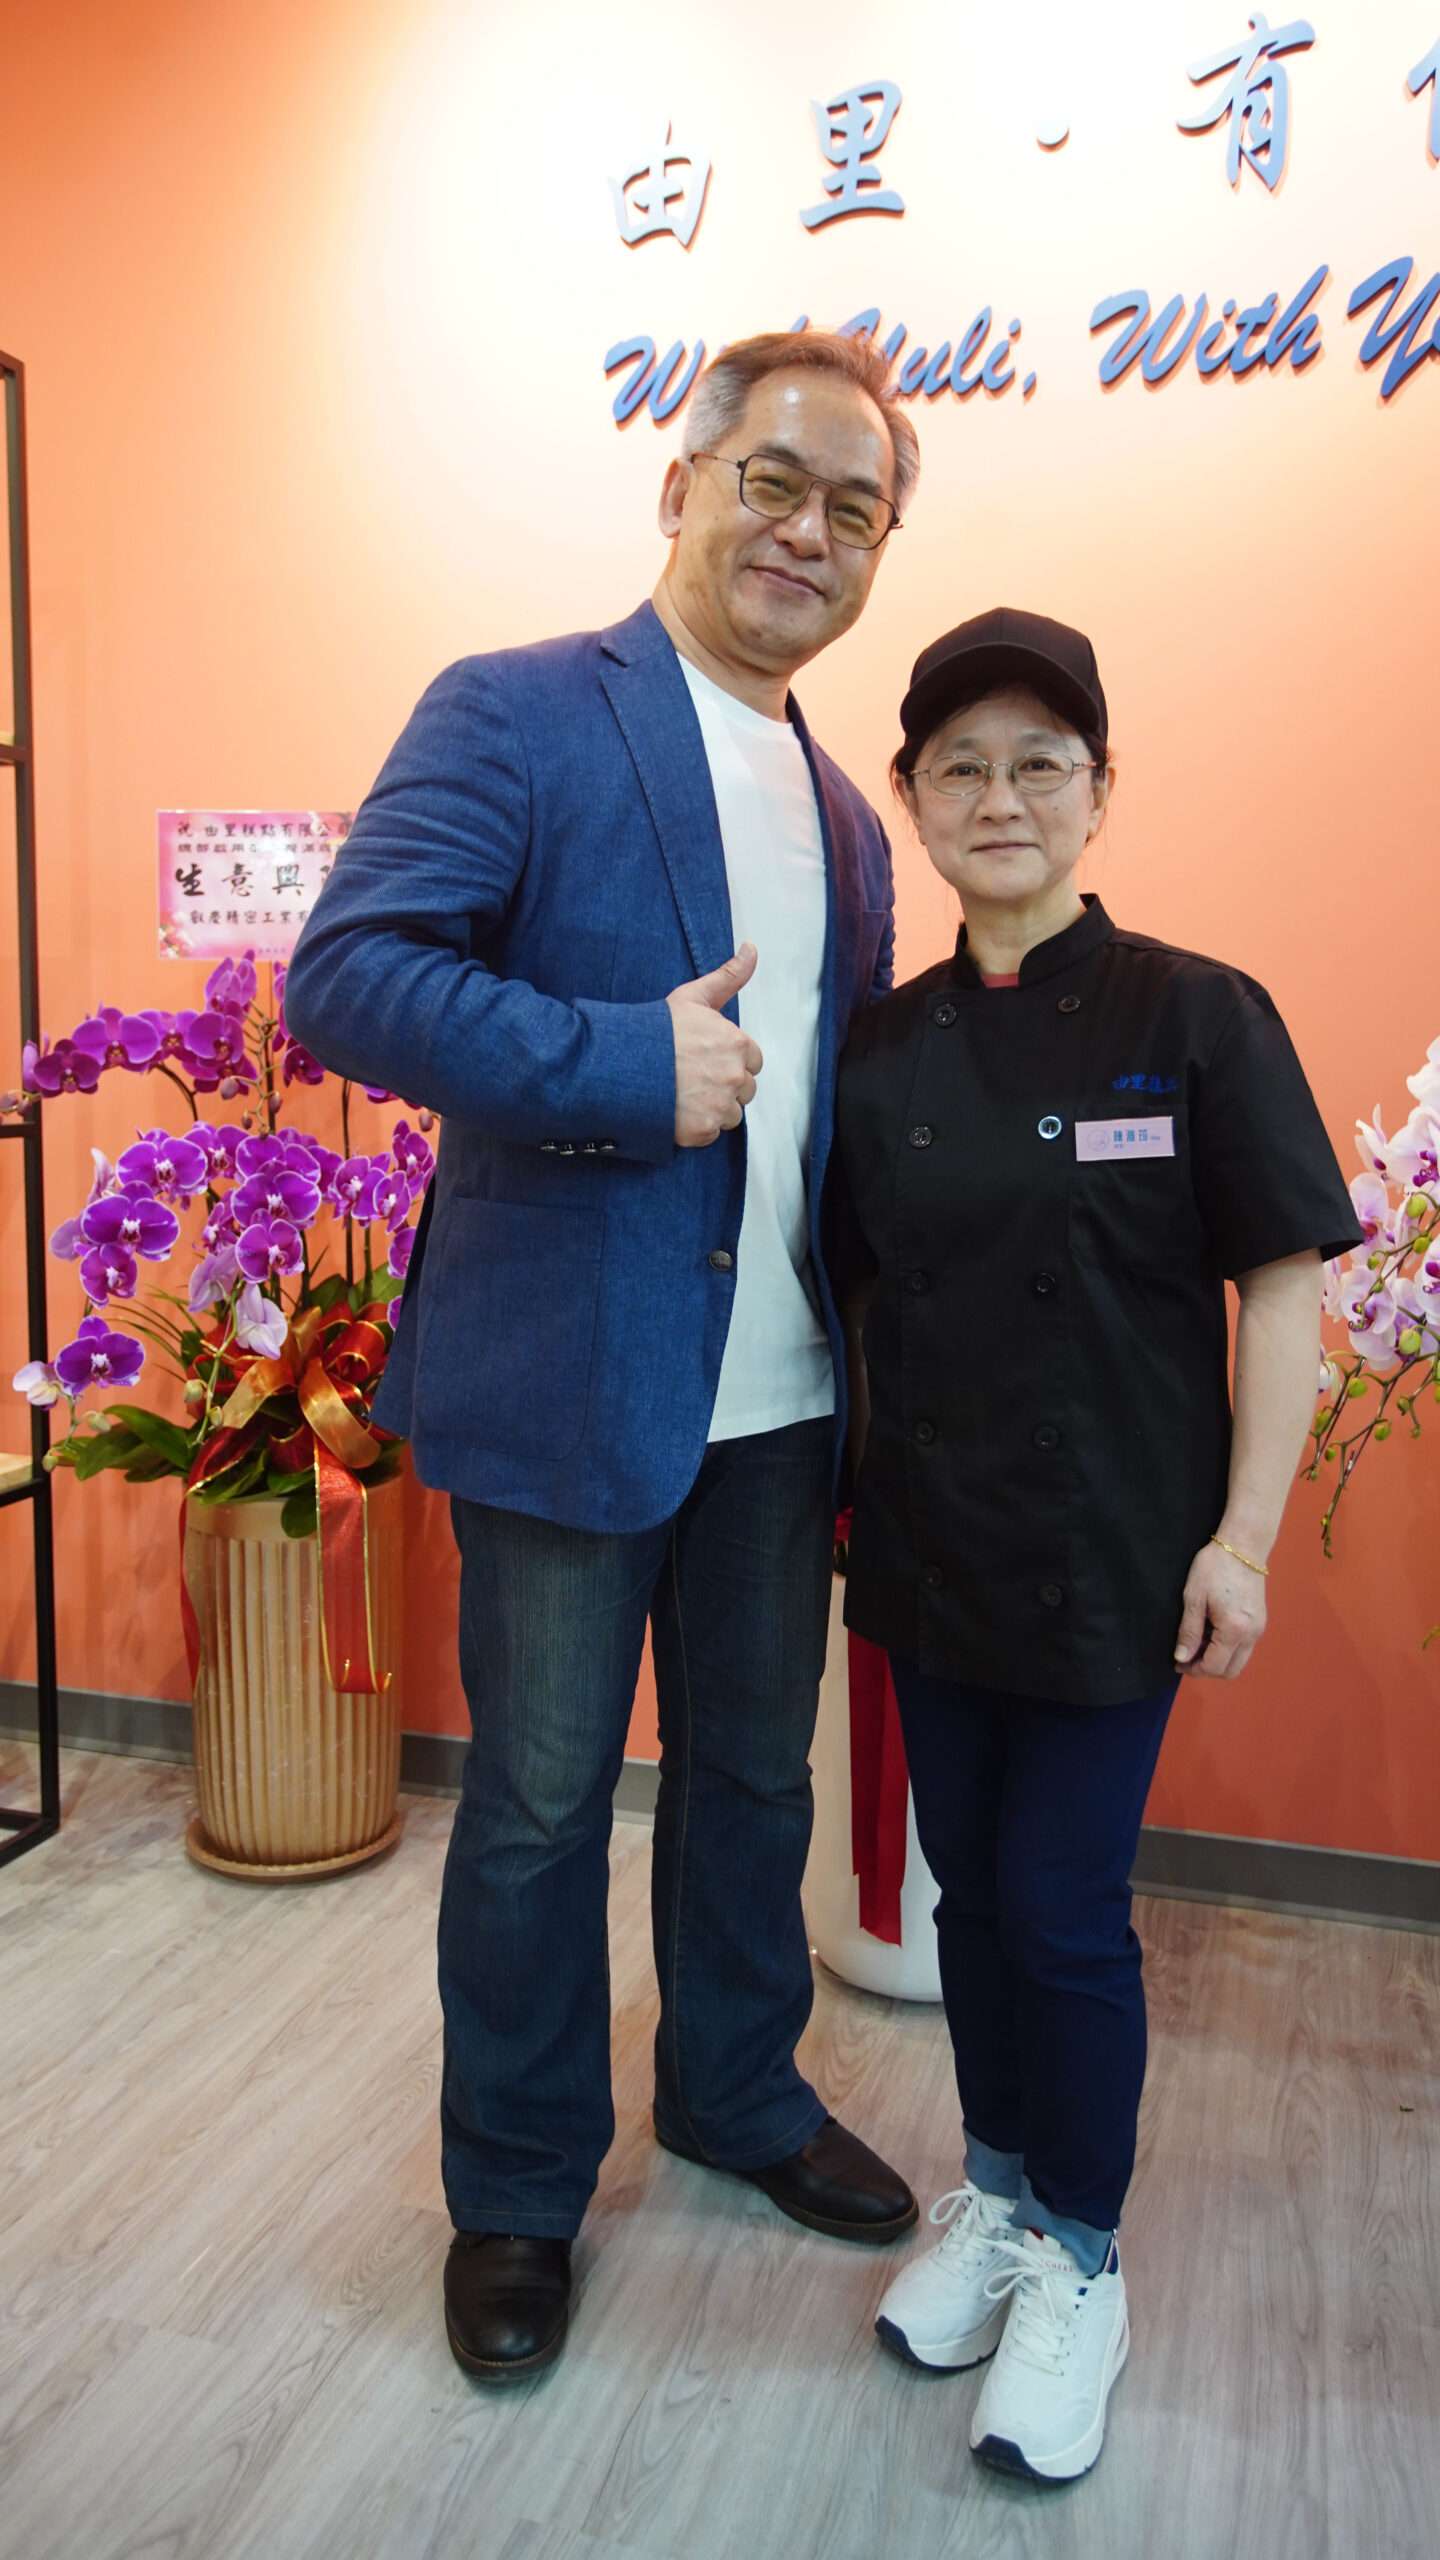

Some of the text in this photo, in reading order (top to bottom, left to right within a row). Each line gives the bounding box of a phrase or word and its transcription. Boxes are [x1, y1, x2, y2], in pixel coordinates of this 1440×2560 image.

[1089, 264, 1330, 386] With
[1347, 256, 1440, 398] Y
[175, 862, 332, 897] 生意興
